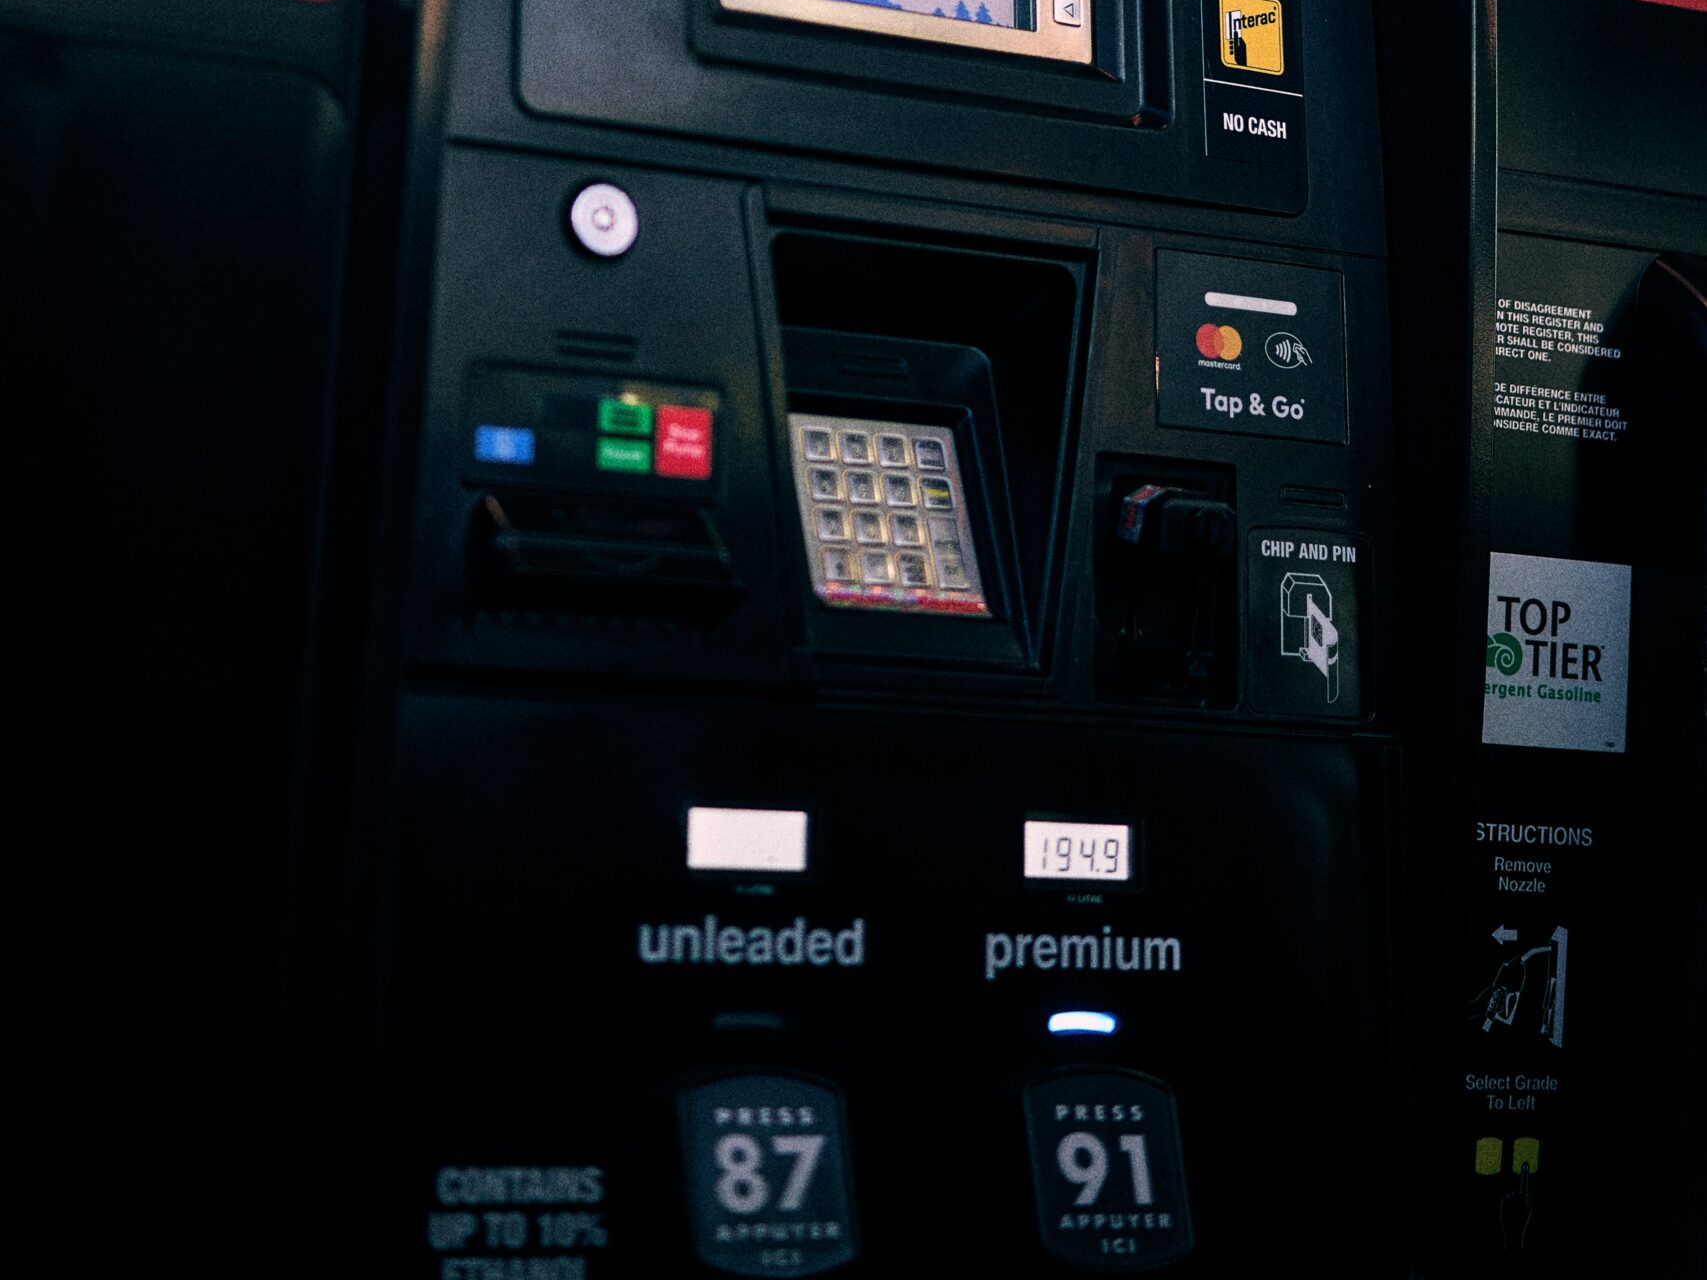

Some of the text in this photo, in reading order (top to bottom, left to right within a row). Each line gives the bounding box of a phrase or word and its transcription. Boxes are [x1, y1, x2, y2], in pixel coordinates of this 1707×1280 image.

[1222, 112, 1287, 140] NO CASH
[1497, 298, 1592, 320] OF DISAGREEMENT
[1507, 311, 1529, 323] THIS
[1531, 315, 1581, 330] REGISTER
[1582, 321, 1605, 333] AND
[1522, 325, 1575, 342] REGISTER,
[1576, 332, 1600, 345] THIS
[1506, 335, 1539, 349] SHALL
[1541, 339, 1555, 350] BE
[1557, 341, 1622, 359] CONSIDERED
[1527, 350, 1552, 362] ONE.
[1200, 386, 1305, 420] Tap & Go
[1509, 383, 1572, 401] DIFFÉRENCE
[1573, 391, 1607, 405] ENTRE
[1538, 399, 1551, 410] ET
[1553, 401, 1621, 418] L'INDICATEUR
[1494, 418, 1618, 442] NSIDÉRÉ COMME EXACT.
[1542, 412, 1556, 423] LE
[1557, 414, 1603, 428] PREMIER
[1604, 419, 1629, 432] DOIT
[1261, 539, 1357, 563] CHIP AND PIN
[1496, 594, 1572, 637] TOP
[1524, 638, 1603, 682] TIER
[1537, 683, 1602, 704] Gasoline
[1041, 836, 1120, 874] 194.9
[1494, 855, 1553, 875] Remove
[1497, 875, 1547, 894] Nozzle
[637, 912, 867, 966] unleaded
[983, 925, 1182, 981] premium
[1464, 1073, 1559, 1091] Select Grade
[1054, 1103, 1145, 1122] PRESS
[1486, 1093, 1537, 1111] To Left
[712, 1130, 830, 1216] 87
[1055, 1130, 1154, 1207] 91
[1057, 1212, 1173, 1231] APPUYER
